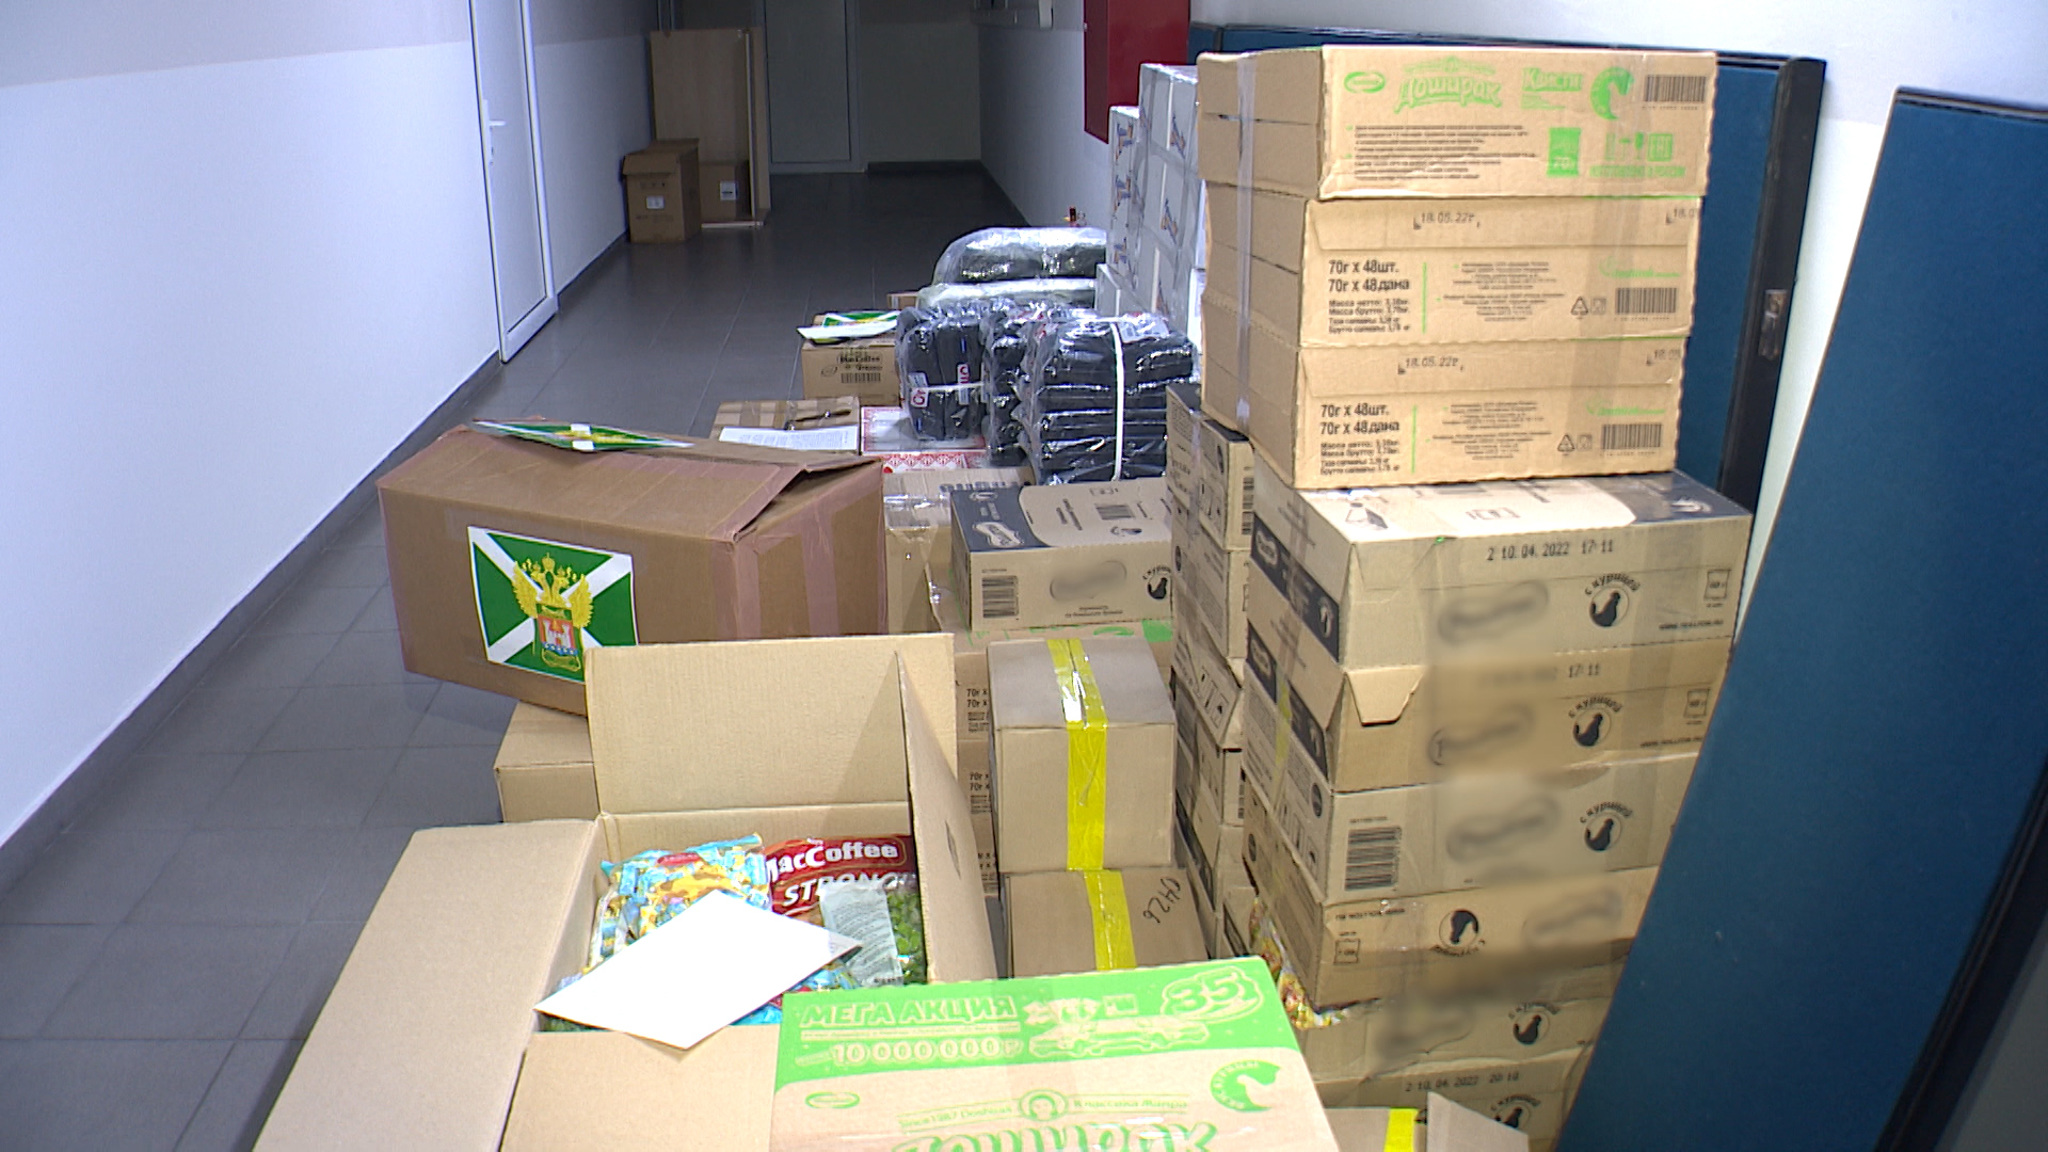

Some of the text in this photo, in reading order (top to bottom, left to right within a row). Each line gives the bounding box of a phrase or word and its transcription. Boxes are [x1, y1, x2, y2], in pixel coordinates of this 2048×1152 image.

[1328, 260, 1349, 274] 70г
[1363, 259, 1400, 274] 48шт.
[1328, 278, 1349, 292] 70г
[1320, 404, 1341, 418] 70г
[1354, 403, 1390, 416] 48шт.
[1320, 422, 1341, 435] 70г
[800, 996, 1018, 1028] МЕГА АКЦИЯ
